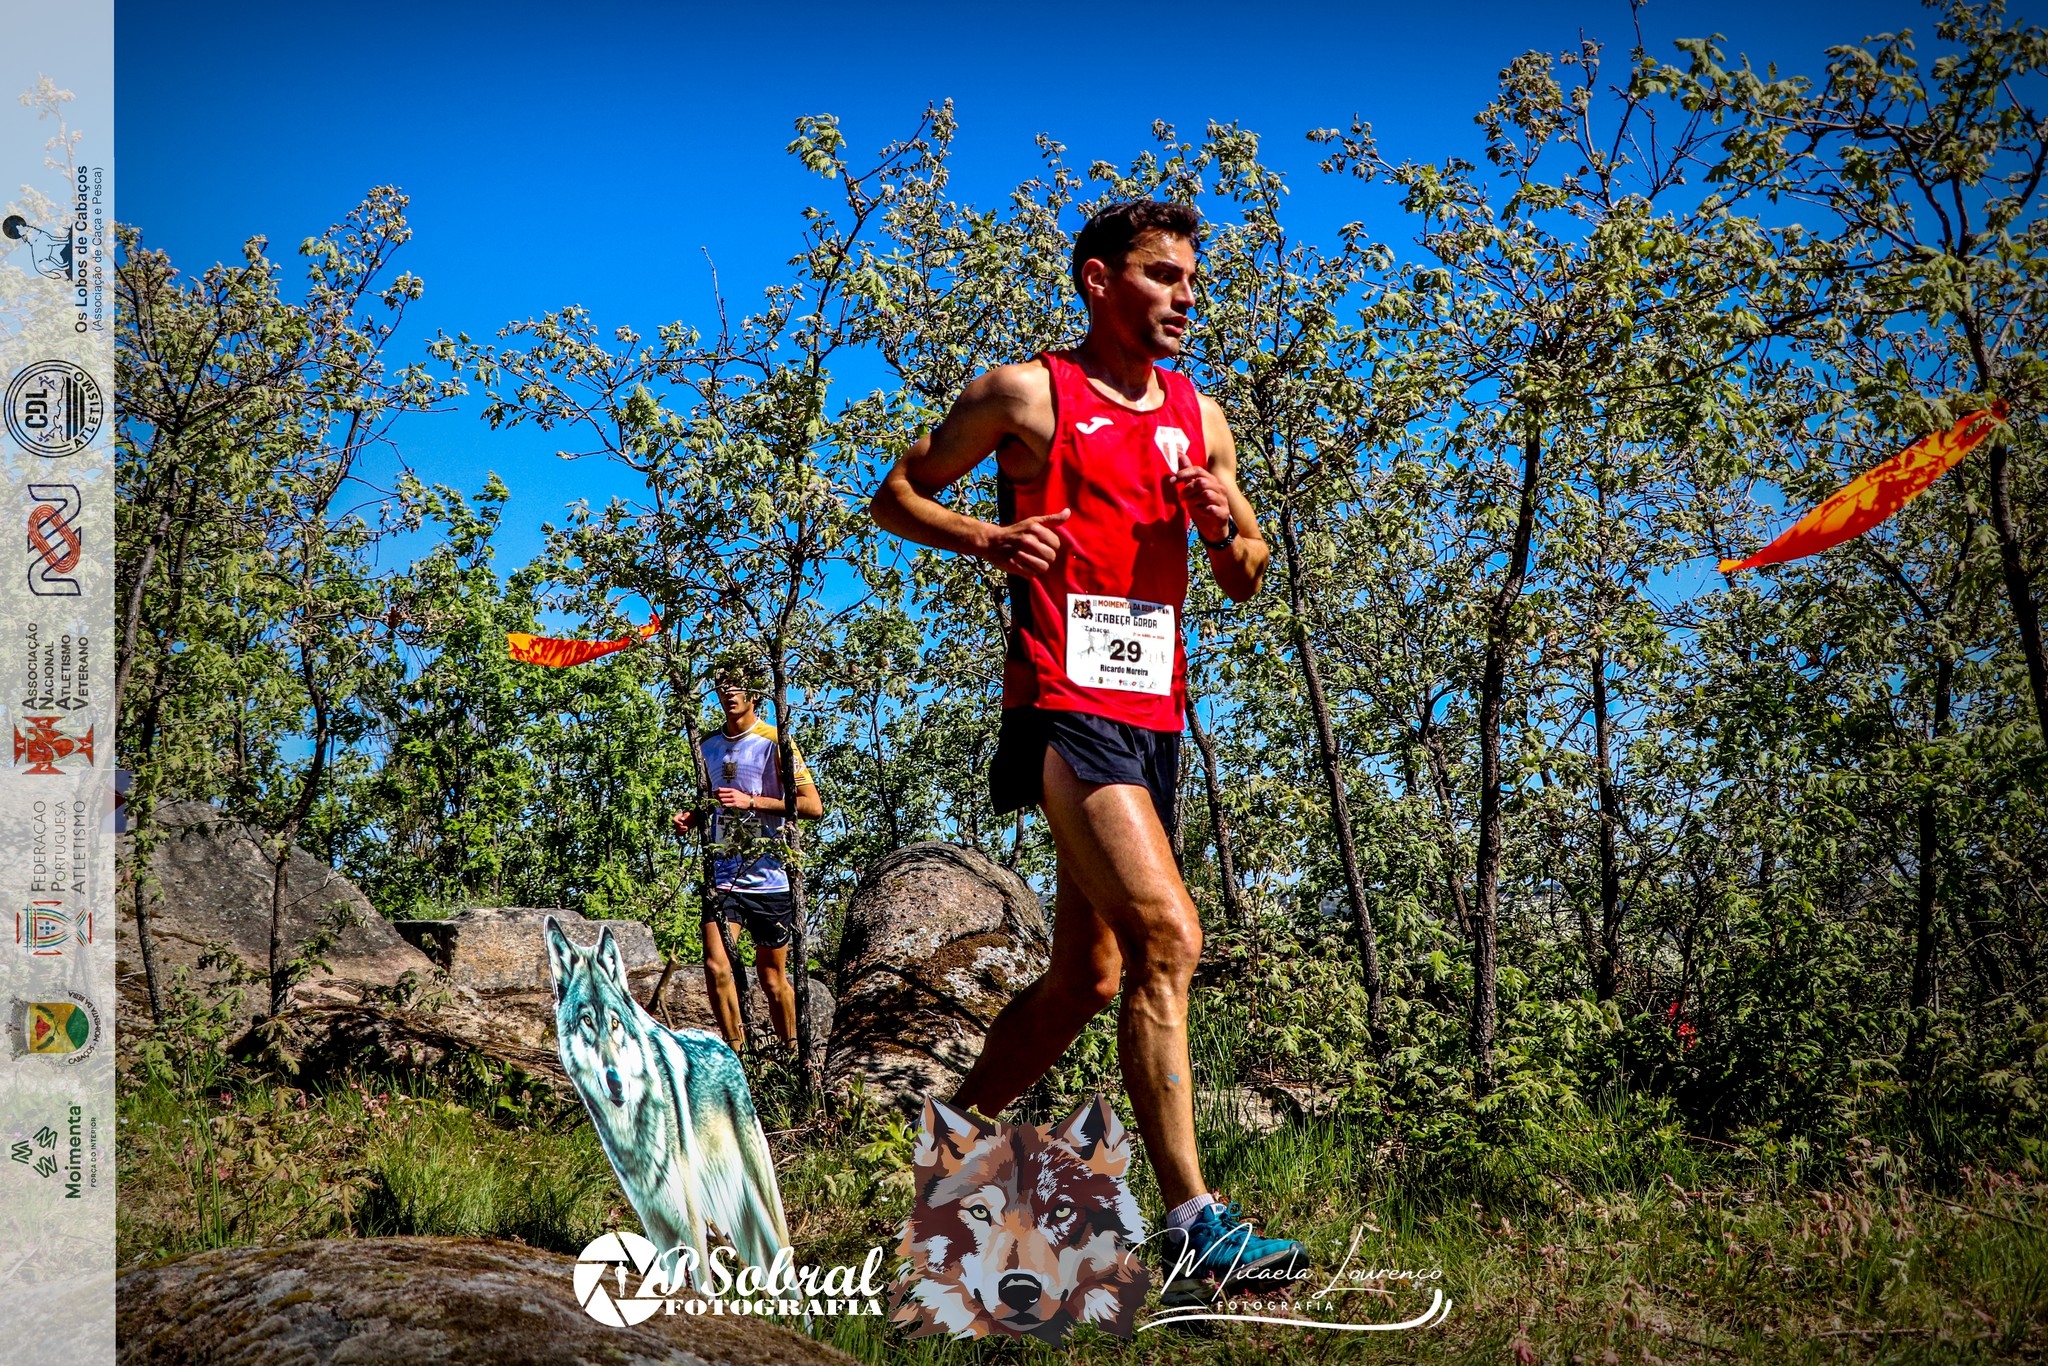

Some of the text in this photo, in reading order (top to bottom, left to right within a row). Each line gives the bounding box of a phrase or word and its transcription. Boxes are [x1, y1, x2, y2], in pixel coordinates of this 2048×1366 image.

[1097, 613, 1157, 628] CABEÇA GORDA
[1109, 639, 1141, 663] 29
[1100, 664, 1148, 676] Ricardo Moreira
